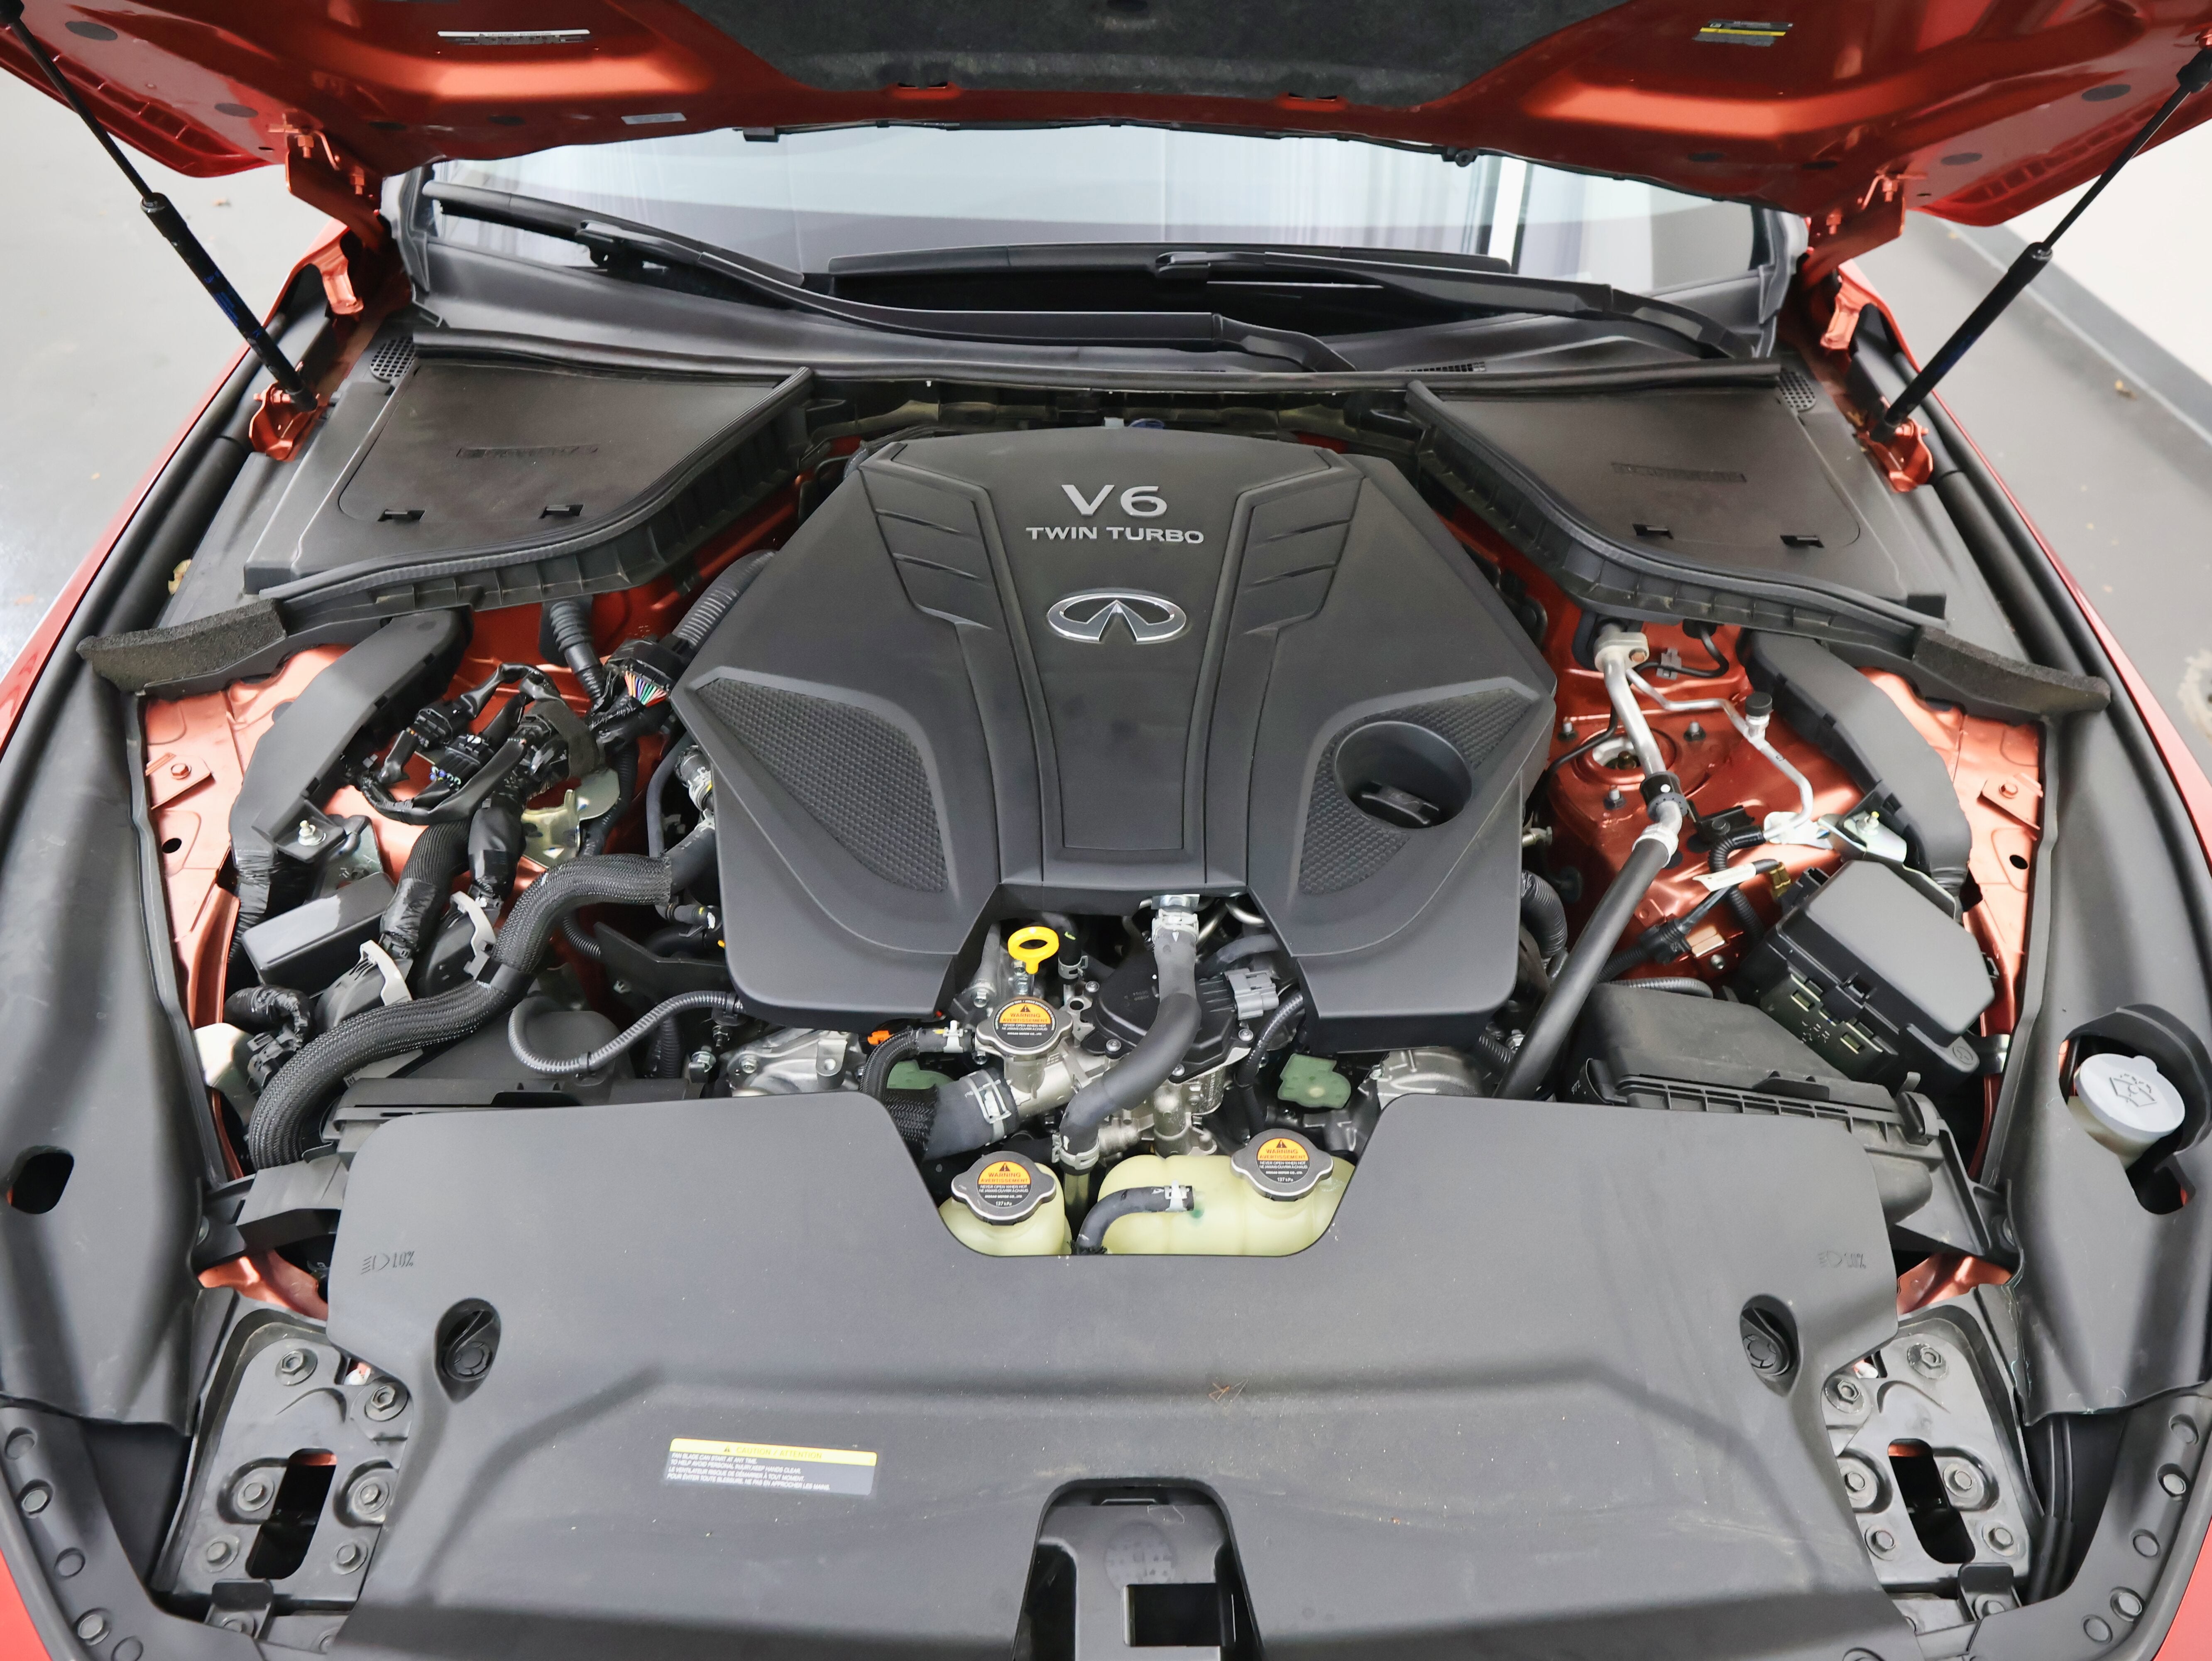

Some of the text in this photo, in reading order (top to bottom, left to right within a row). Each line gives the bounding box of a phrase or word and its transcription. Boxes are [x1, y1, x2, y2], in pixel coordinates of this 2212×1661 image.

[1061, 484, 1167, 518] V6
[1026, 527, 1204, 544] TWIN TURBO
[736, 1446, 771, 1455] CAUTION
[779, 1450, 822, 1459] ATTENTION
[675, 1466, 709, 1475] VENTILATEUR
[707, 1461, 734, 1470] PERSONAL
[770, 1480, 803, 1489] APPROCHER
